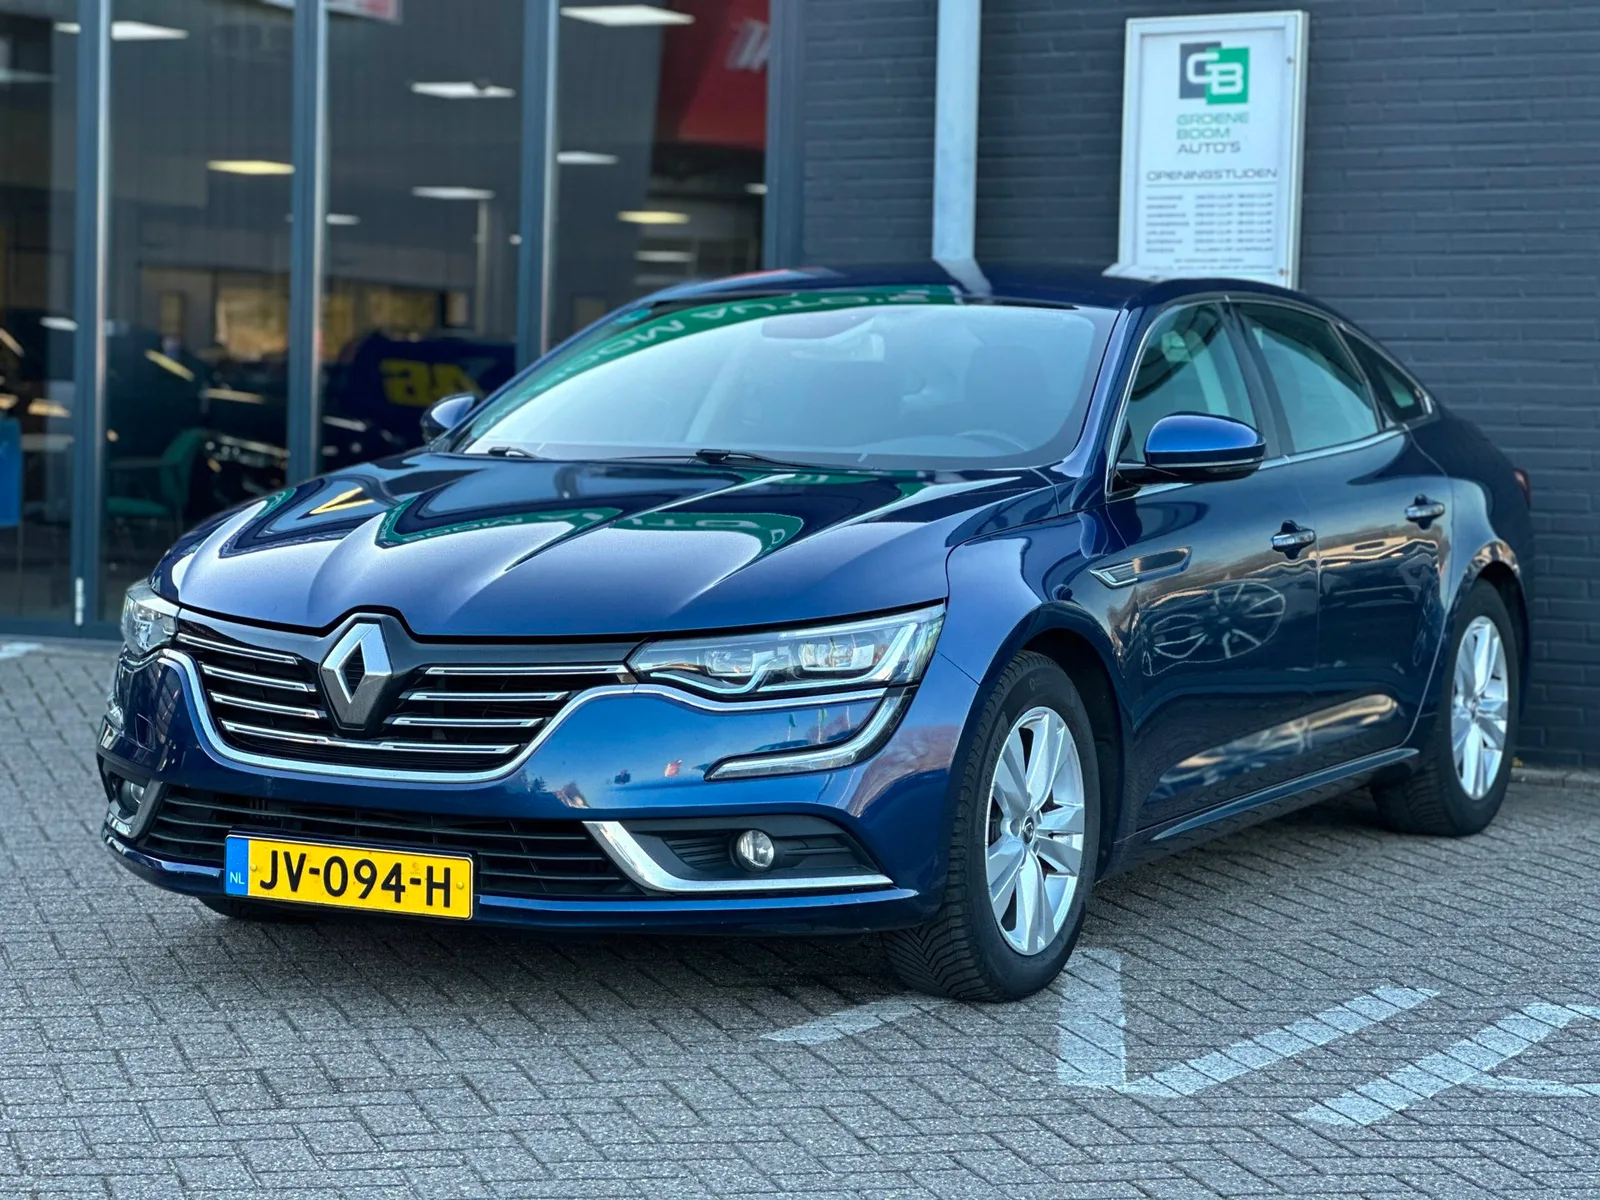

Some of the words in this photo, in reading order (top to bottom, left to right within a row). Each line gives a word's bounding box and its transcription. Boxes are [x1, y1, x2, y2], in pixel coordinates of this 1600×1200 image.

[1176, 111, 1250, 125] GROENE
[1176, 127, 1230, 140] BOOM
[1177, 140, 1241, 154] AUTO'S
[229, 871, 246, 886] NL
[259, 849, 451, 908] JV-094-H
